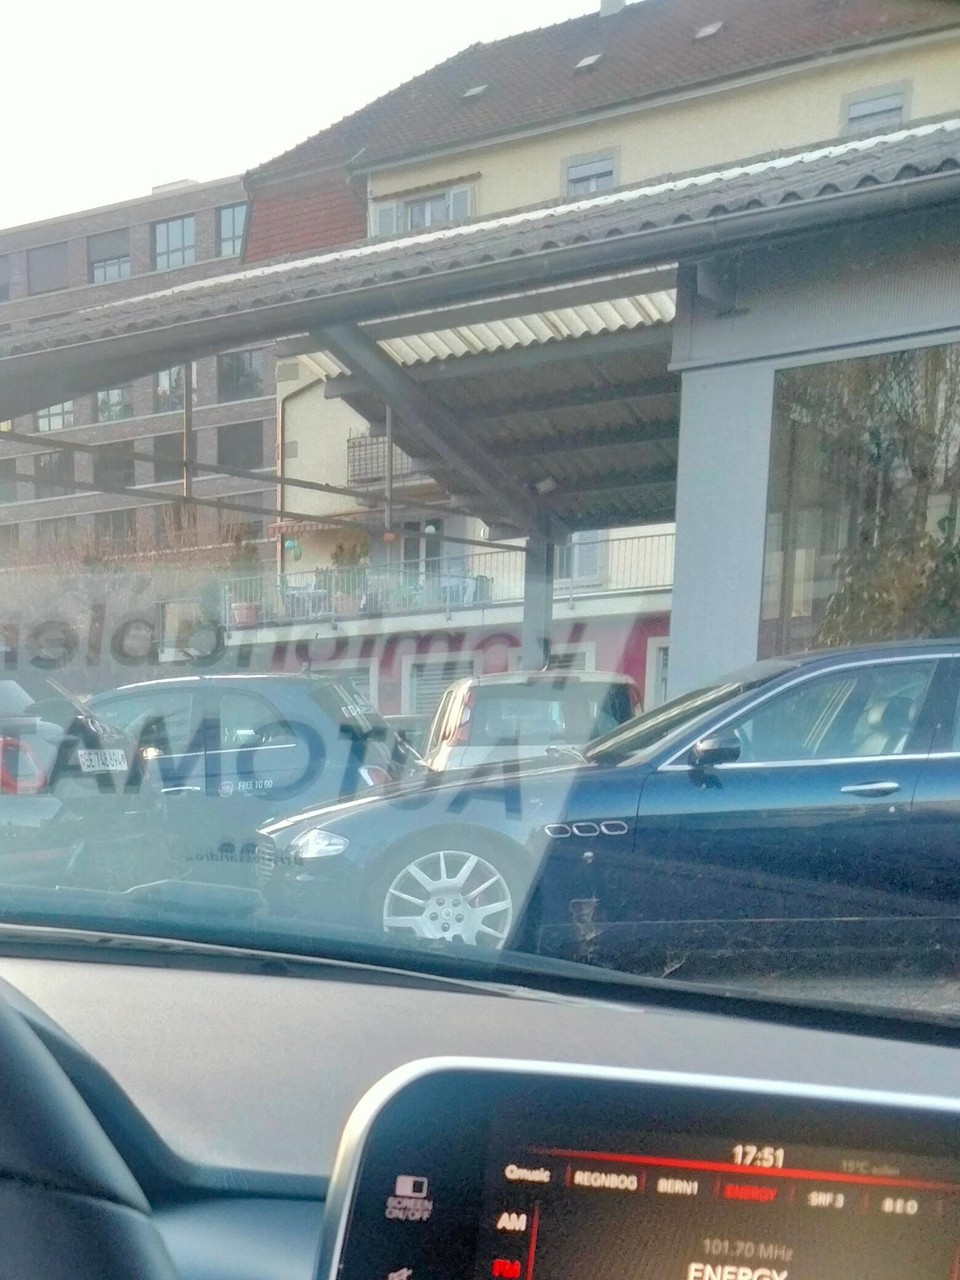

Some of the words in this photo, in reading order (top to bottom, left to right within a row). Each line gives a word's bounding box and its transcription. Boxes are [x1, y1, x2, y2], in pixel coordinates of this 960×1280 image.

[239, 781, 253, 790] FREE
[732, 1144, 785, 1168] 17:51
[496, 1212, 527, 1232] AM
[759, 1243, 794, 1261] MHz
[492, 1258, 521, 1280] FM
